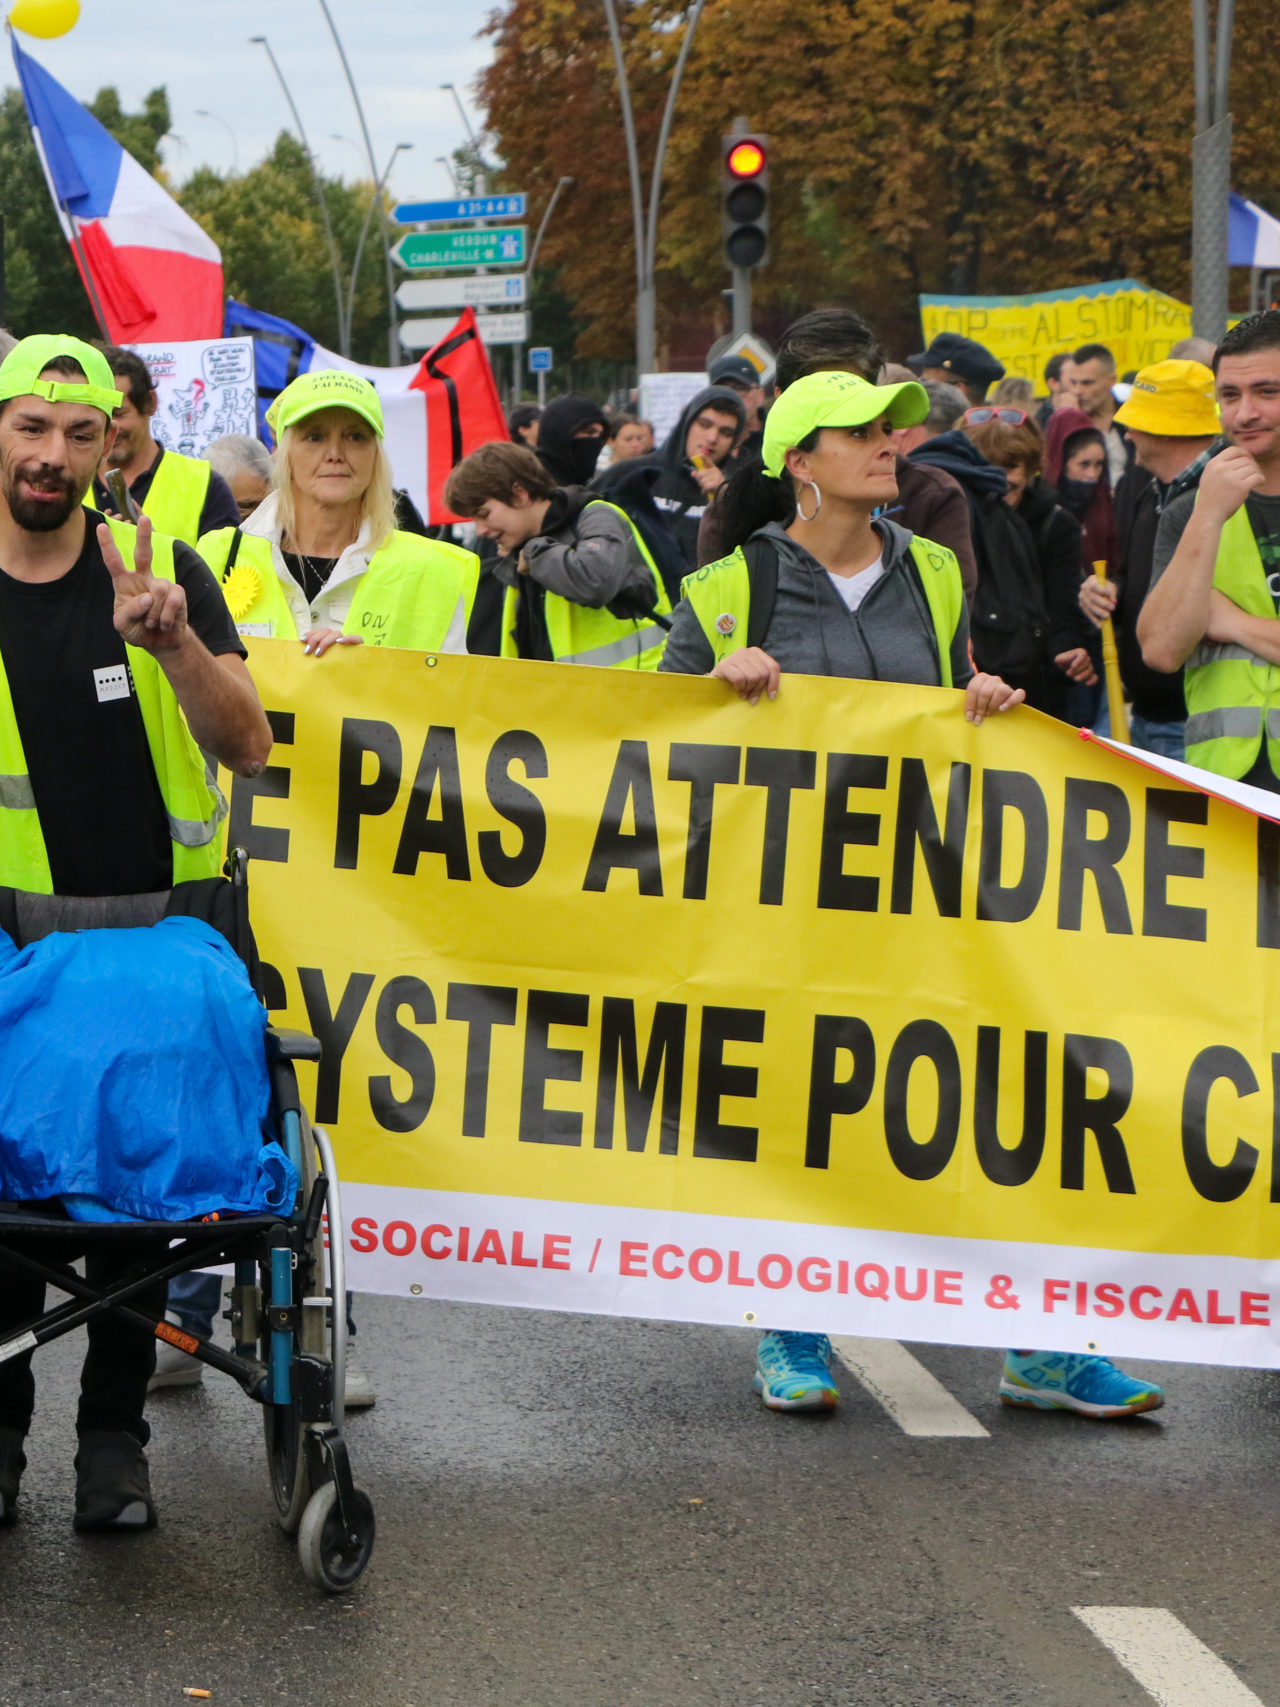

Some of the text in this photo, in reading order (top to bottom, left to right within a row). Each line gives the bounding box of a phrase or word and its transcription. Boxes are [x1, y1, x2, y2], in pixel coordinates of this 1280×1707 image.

[453, 234, 498, 247] VERDUN
[333, 717, 549, 888] PAS
[581, 738, 1210, 943] ATTENDRE
[804, 1014, 1137, 1196] POUR
[1181, 1044, 1280, 1205] C
[349, 1217, 572, 1271] SOCIALE
[619, 1241, 964, 1306] ECOLOGIQUE
[984, 1274, 1021, 1311] &
[1043, 1279, 1272, 1327] FISCALE
